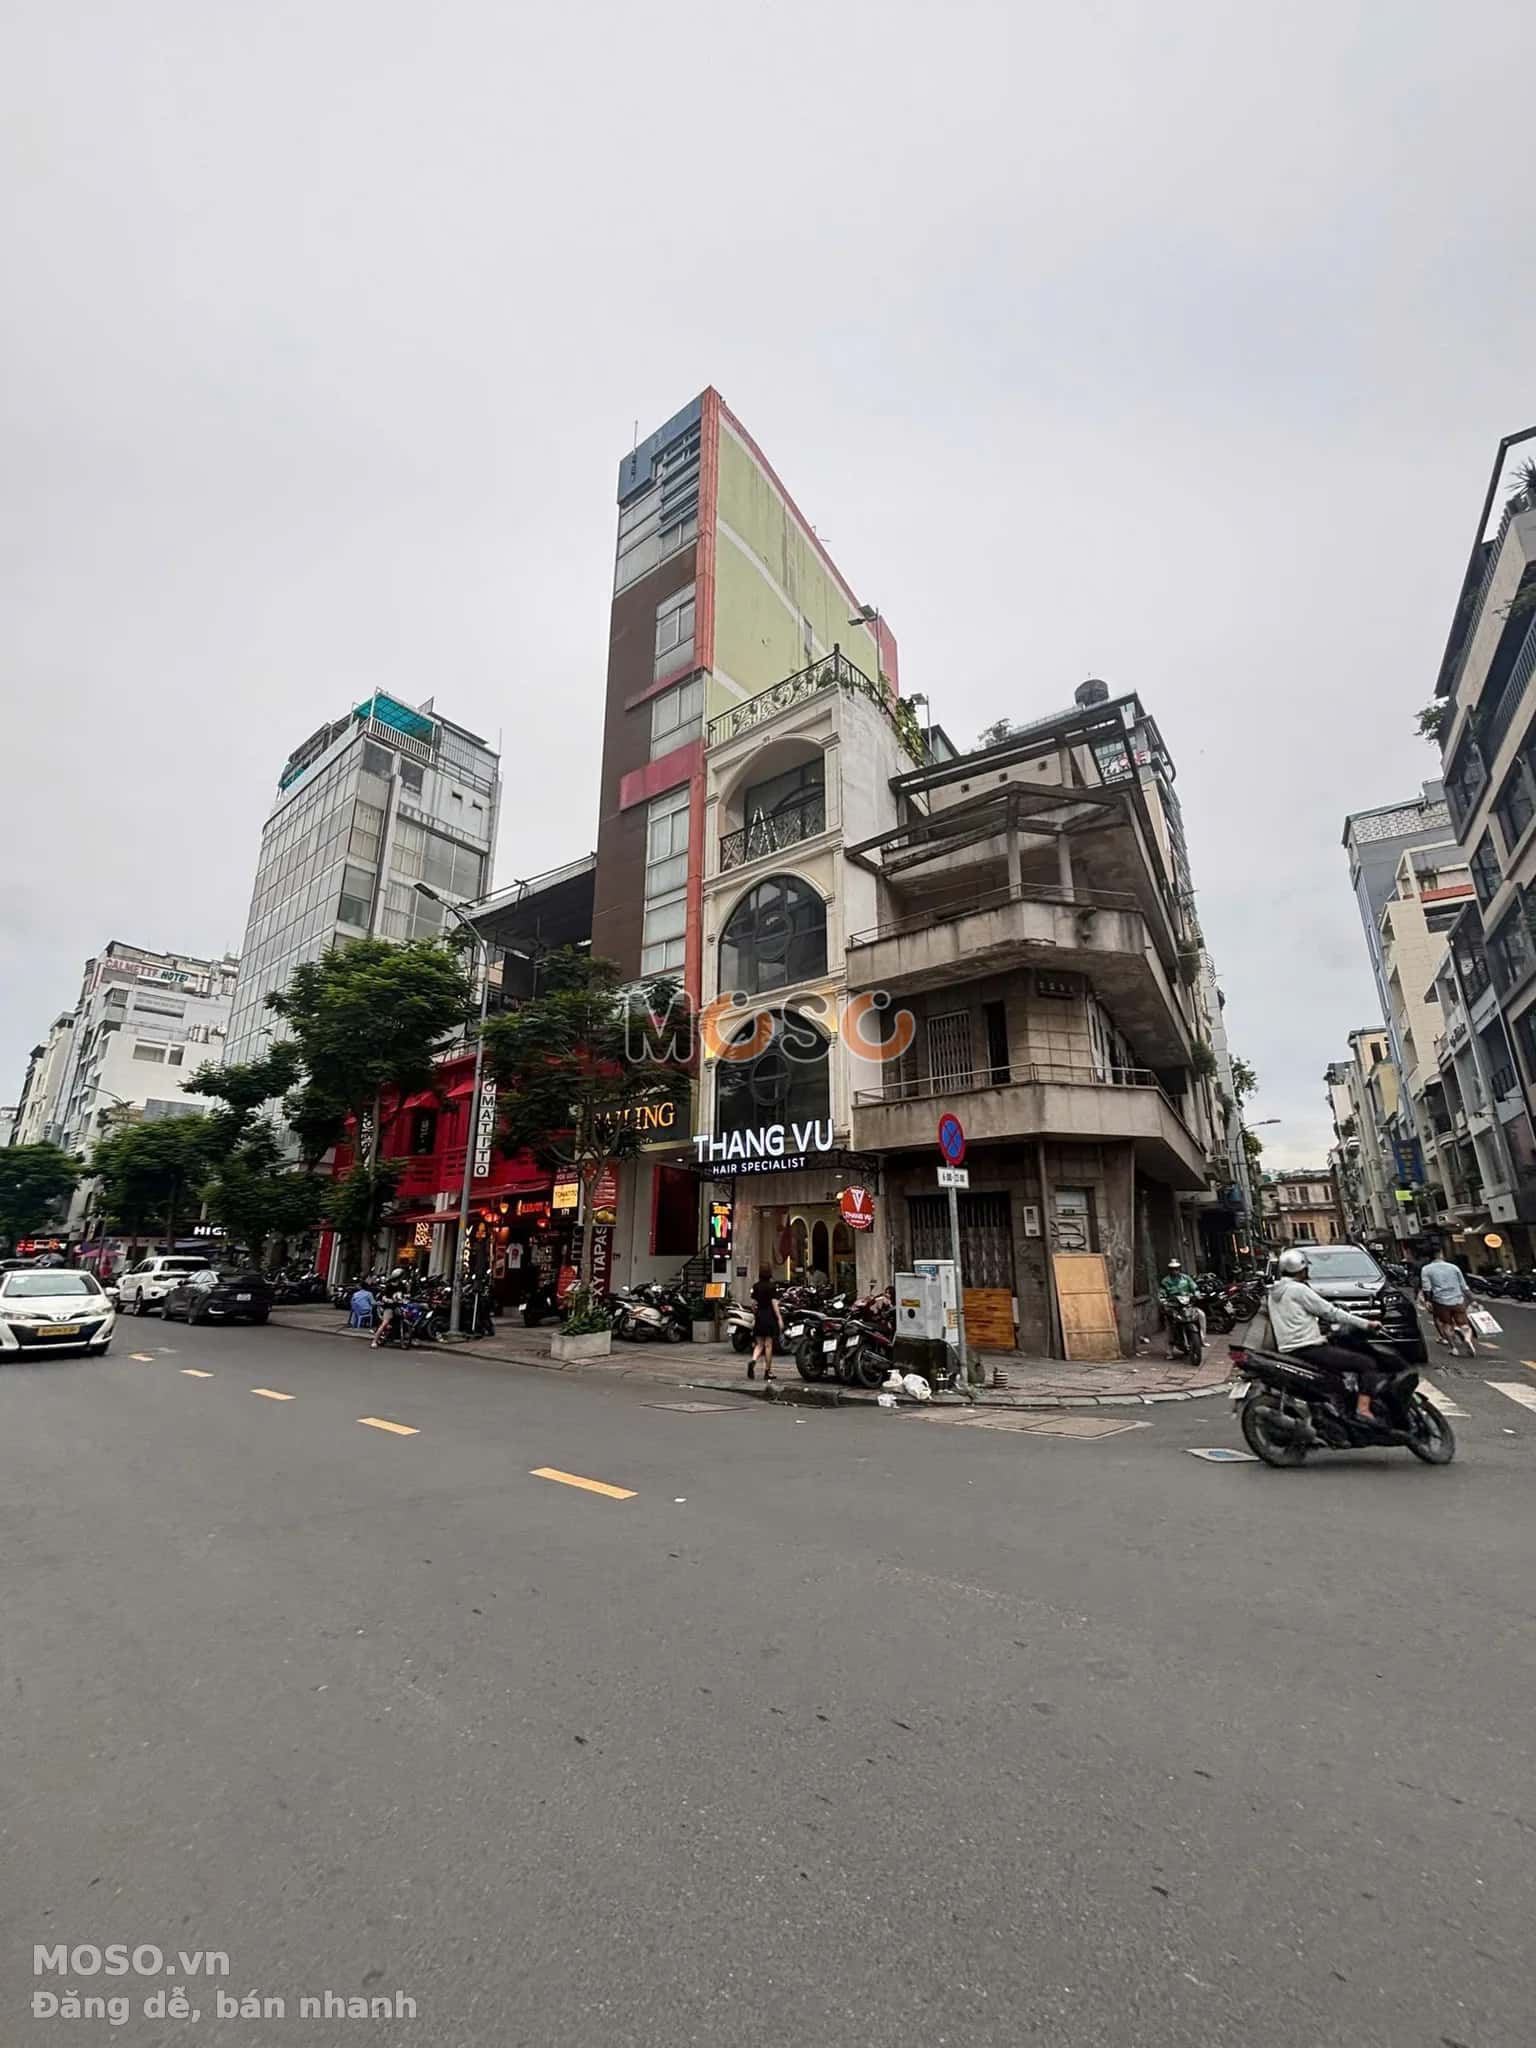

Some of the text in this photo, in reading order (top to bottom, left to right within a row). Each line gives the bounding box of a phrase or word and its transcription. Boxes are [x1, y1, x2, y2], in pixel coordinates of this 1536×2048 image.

[475, 1068, 495, 1176] OMATITO
[692, 1118, 834, 1163] THANG VU
[712, 1157, 806, 1175] HAIR SPECIALIST
[593, 1226, 608, 1274] TAPAS
